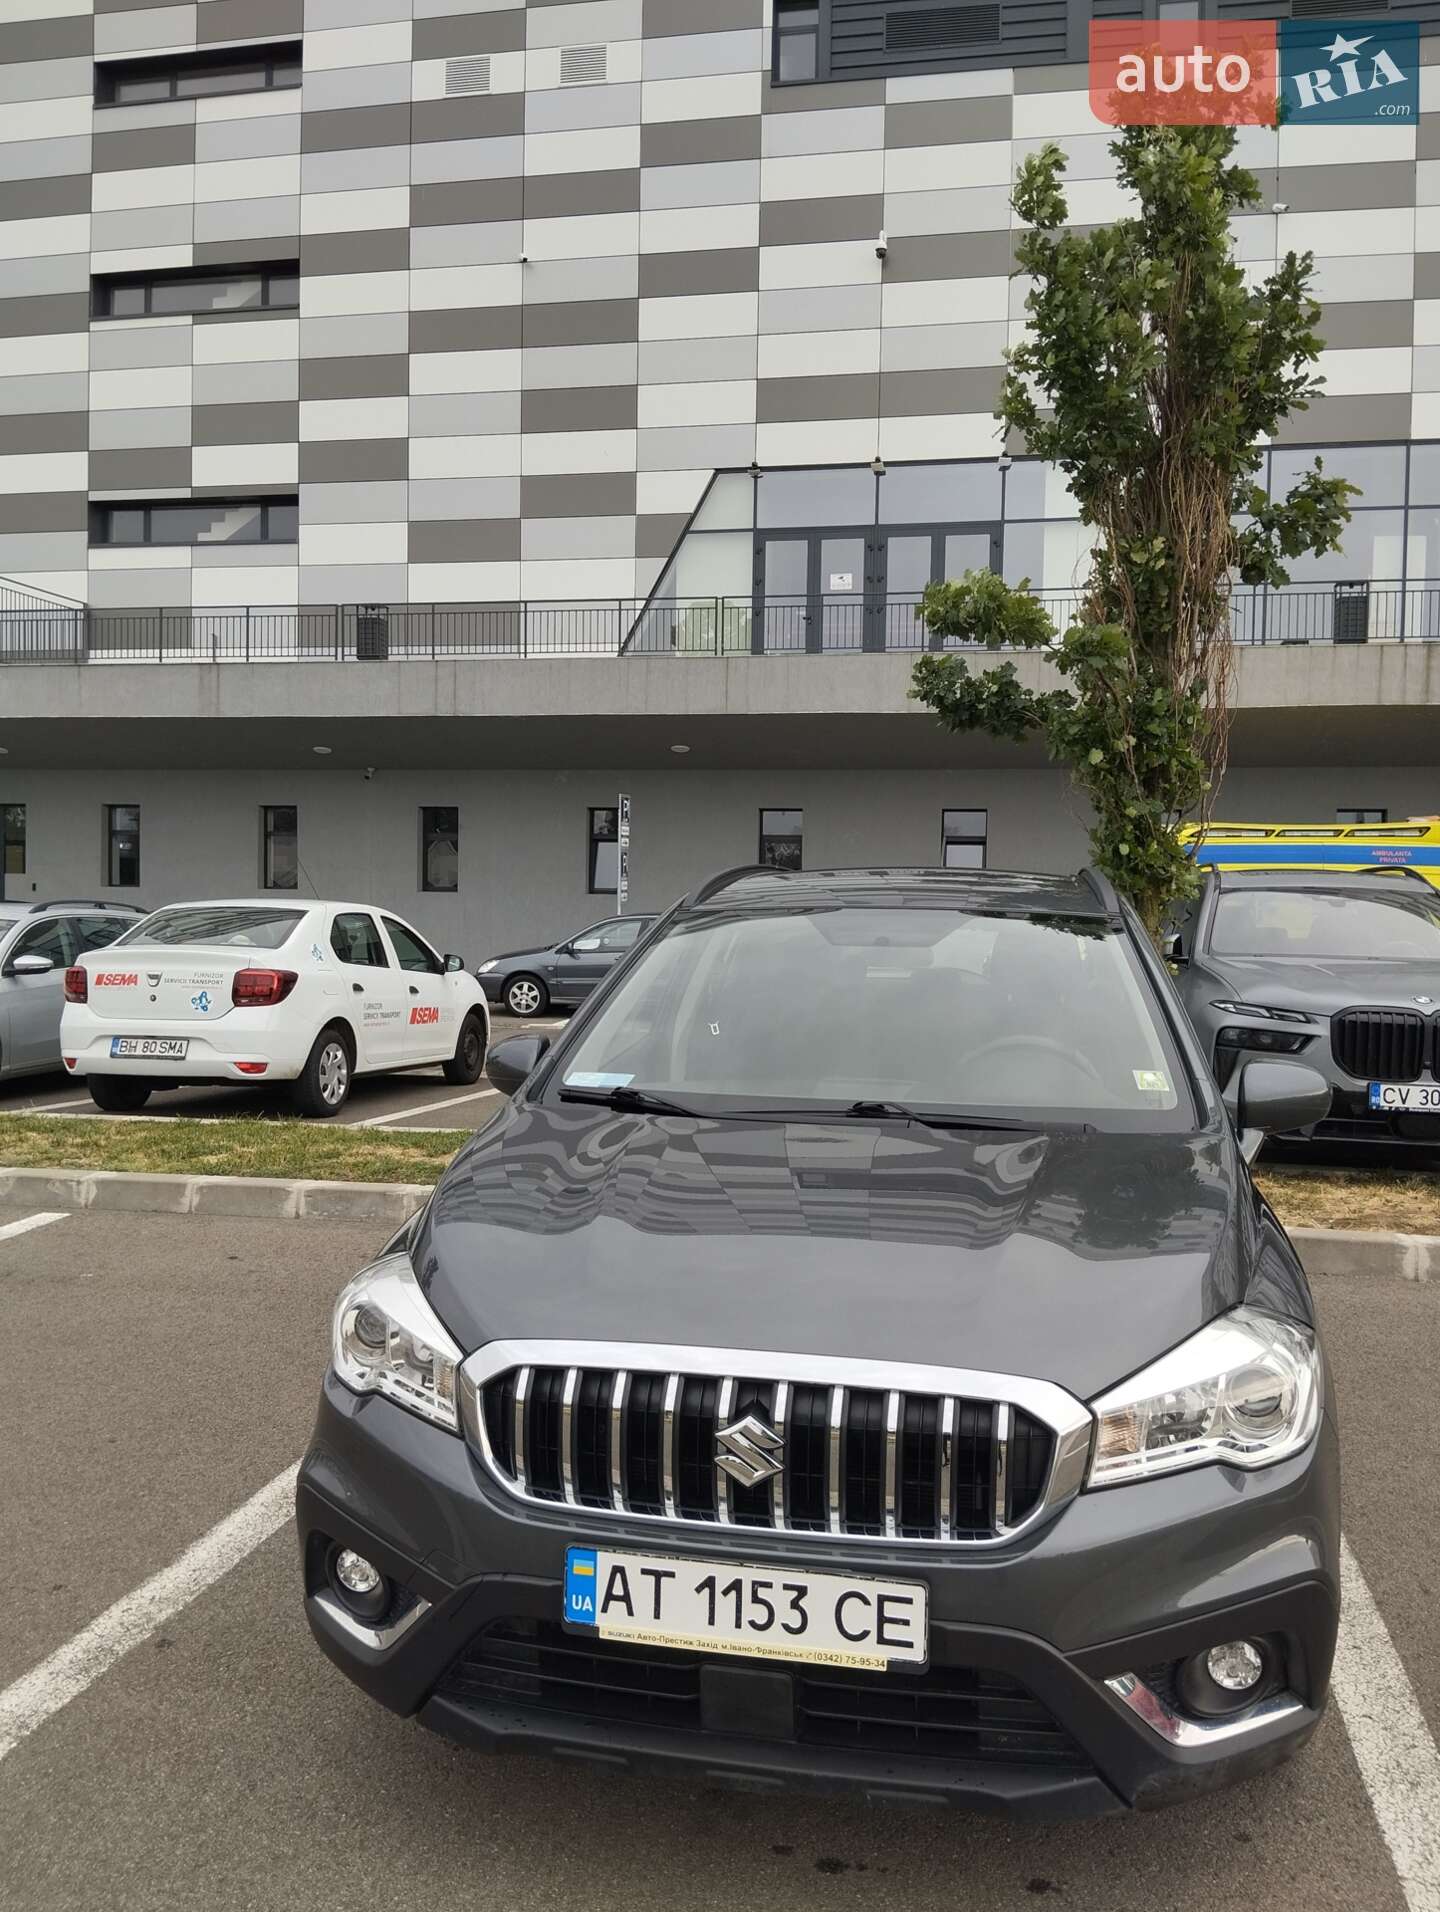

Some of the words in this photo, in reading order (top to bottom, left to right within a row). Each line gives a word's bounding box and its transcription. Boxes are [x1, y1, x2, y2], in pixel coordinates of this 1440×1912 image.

[104, 974, 138, 986] SEMA
[416, 1007, 439, 1024] SEMA
[119, 1040, 138, 1053] BH
[142, 1040, 158, 1053] 80
[159, 1041, 183, 1054] SMA
[1383, 1087, 1410, 1105] CV
[1419, 1089, 1440, 1106] 30
[572, 1594, 593, 1612] UA
[600, 1565, 676, 1620] AT
[694, 1575, 809, 1635] 1153
[835, 1591, 915, 1649] CE
[637, 1632, 694, 1646] Авто-Престиж
[696, 1639, 718, 1649] Захід
[814, 1653, 843, 1664] (0342)
[846, 1655, 886, 1668] 75-95-34
